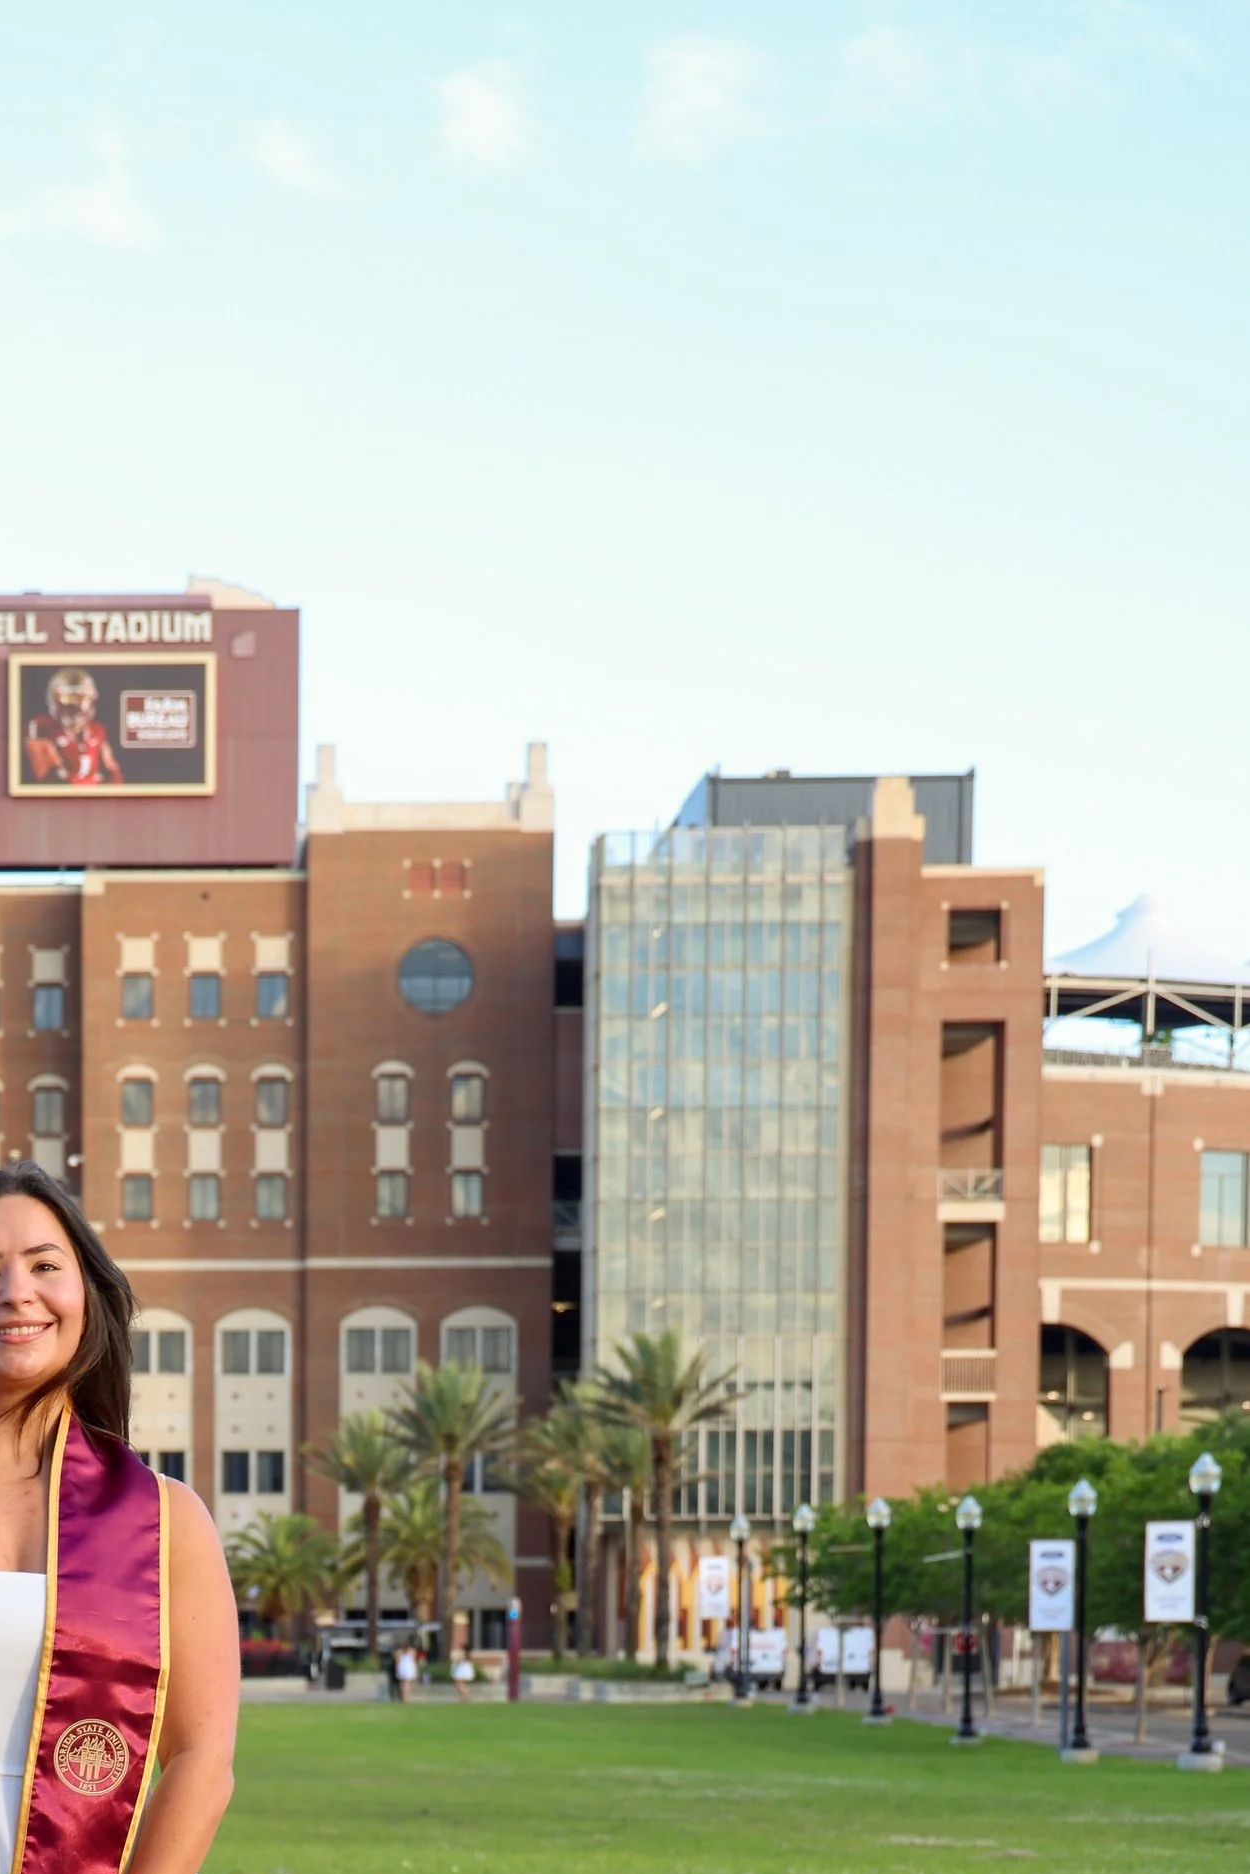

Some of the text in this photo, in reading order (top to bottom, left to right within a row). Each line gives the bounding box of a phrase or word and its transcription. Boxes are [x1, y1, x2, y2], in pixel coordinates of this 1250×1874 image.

[63, 611, 213, 643] STADIUM
[59, 1724, 125, 1782] FLORIDA STATE UNIVERSITY
[79, 1782, 97, 1791] 1851
